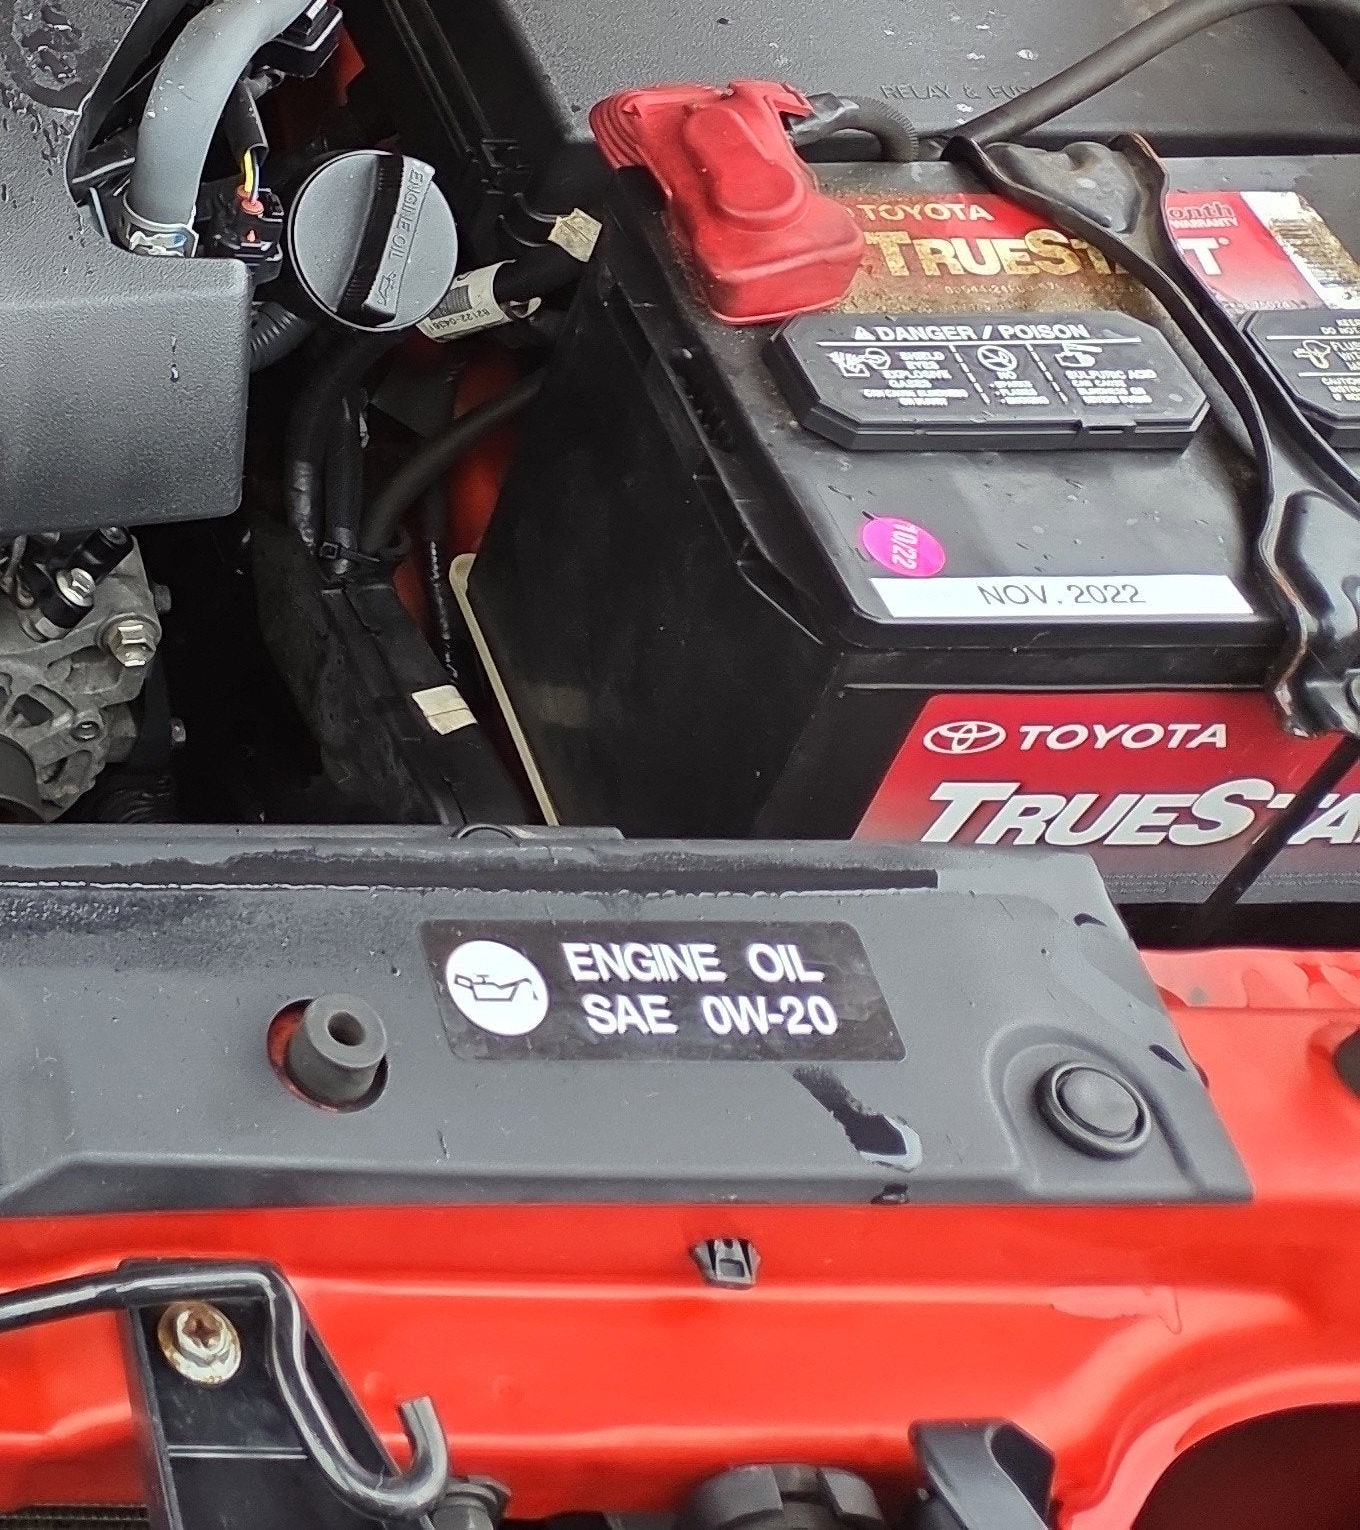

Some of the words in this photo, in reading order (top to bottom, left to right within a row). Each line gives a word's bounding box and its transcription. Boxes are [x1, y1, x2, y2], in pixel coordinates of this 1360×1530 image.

[880, 83, 951, 100] RELAY
[962, 83, 982, 100] &
[396, 169, 423, 232] ENGINE
[857, 203, 995, 221] TOYOTA
[1167, 201, 1235, 219] onth
[388, 233, 406, 260] OIL
[875, 326, 978, 340] DANGER
[982, 325, 993, 340] /
[997, 324, 1091, 339] POISON
[1067, 583, 1147, 604] 2022
[1018, 723, 1227, 751] TOYOTA
[561, 941, 728, 983] ENGINE
[746, 942, 825, 983] OIL
[583, 993, 679, 1036] SAE
[701, 994, 840, 1037] 0W-20
